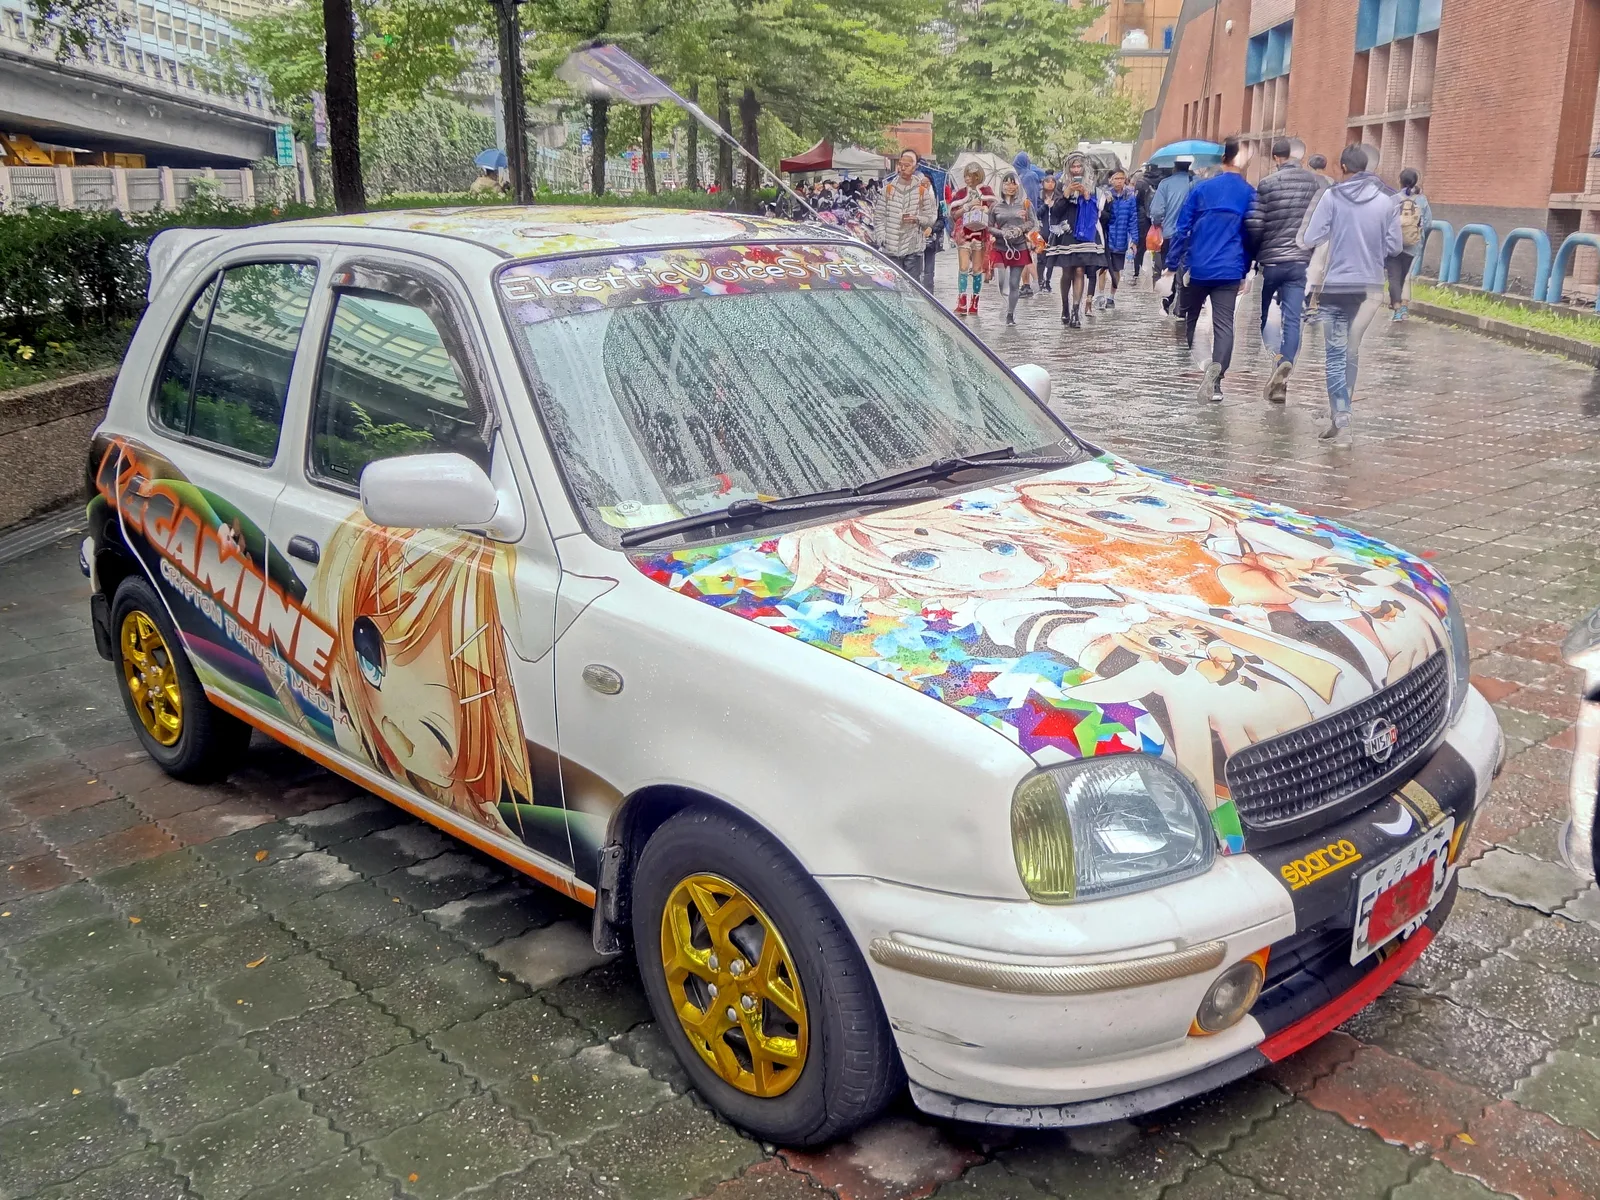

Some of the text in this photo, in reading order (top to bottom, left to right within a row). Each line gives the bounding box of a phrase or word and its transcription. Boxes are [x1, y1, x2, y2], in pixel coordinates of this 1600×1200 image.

[160, 558, 352, 733] CRYPTON FUTURE MEDIA
[1281, 839, 1358, 886] sparco
